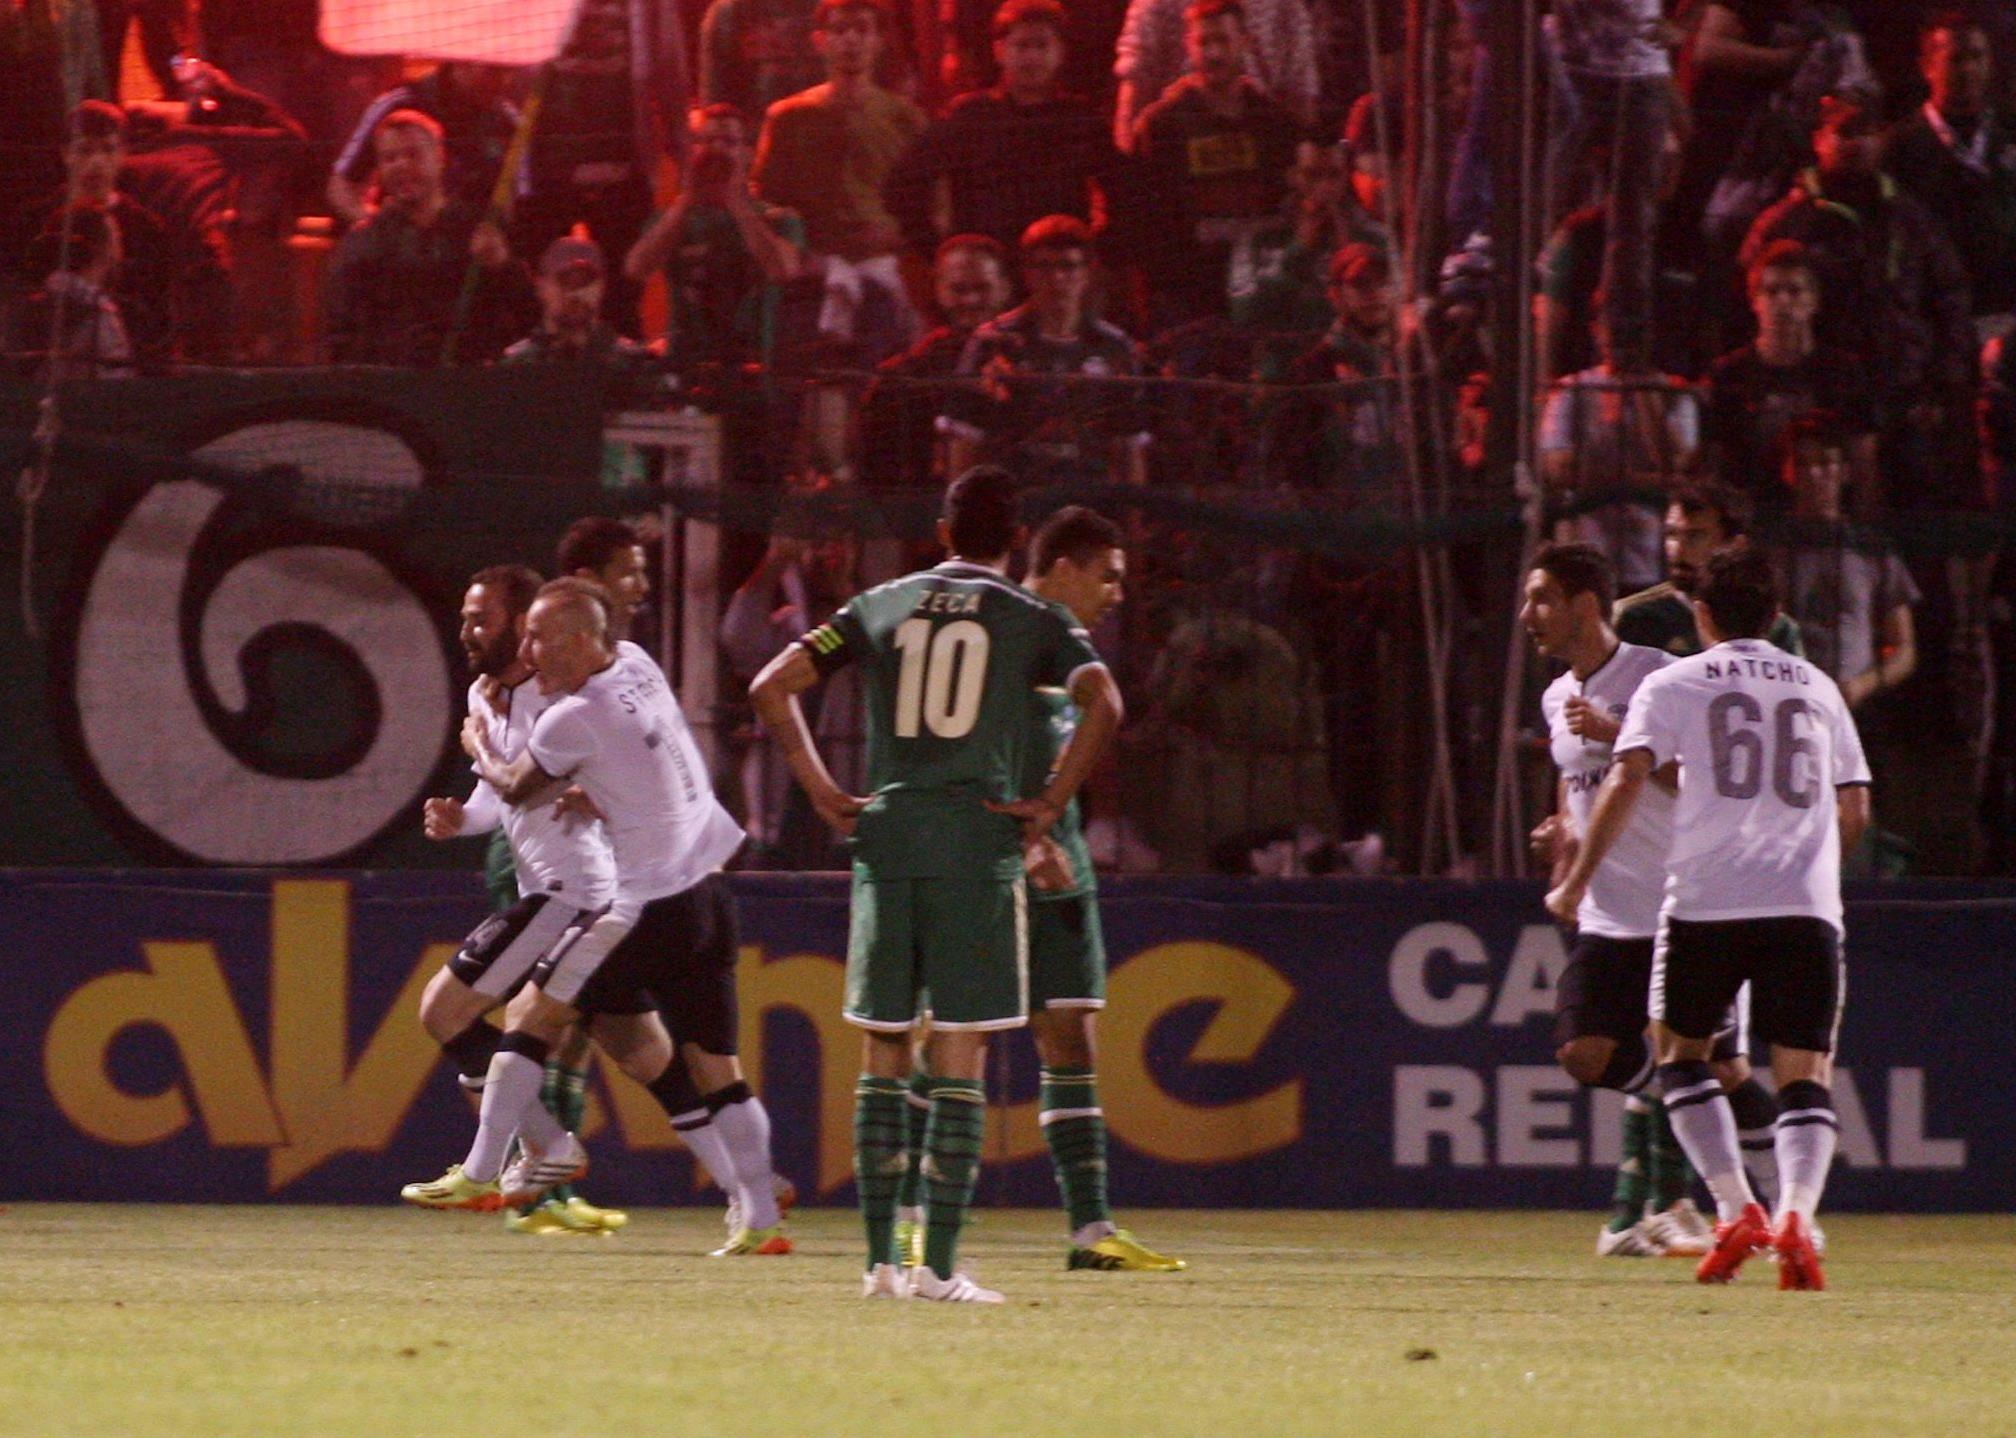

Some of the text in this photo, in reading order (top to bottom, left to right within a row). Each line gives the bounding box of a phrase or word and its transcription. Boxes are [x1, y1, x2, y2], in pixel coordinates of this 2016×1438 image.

[916, 589, 982, 613] ZECA
[893, 617, 989, 738] 10
[1706, 658, 1810, 685] NATCHO
[1708, 691, 1822, 809] 66
[1388, 921, 1562, 1028] CA
[43, 880, 1303, 1192] avne
[1393, 1065, 1967, 1168] REAL
